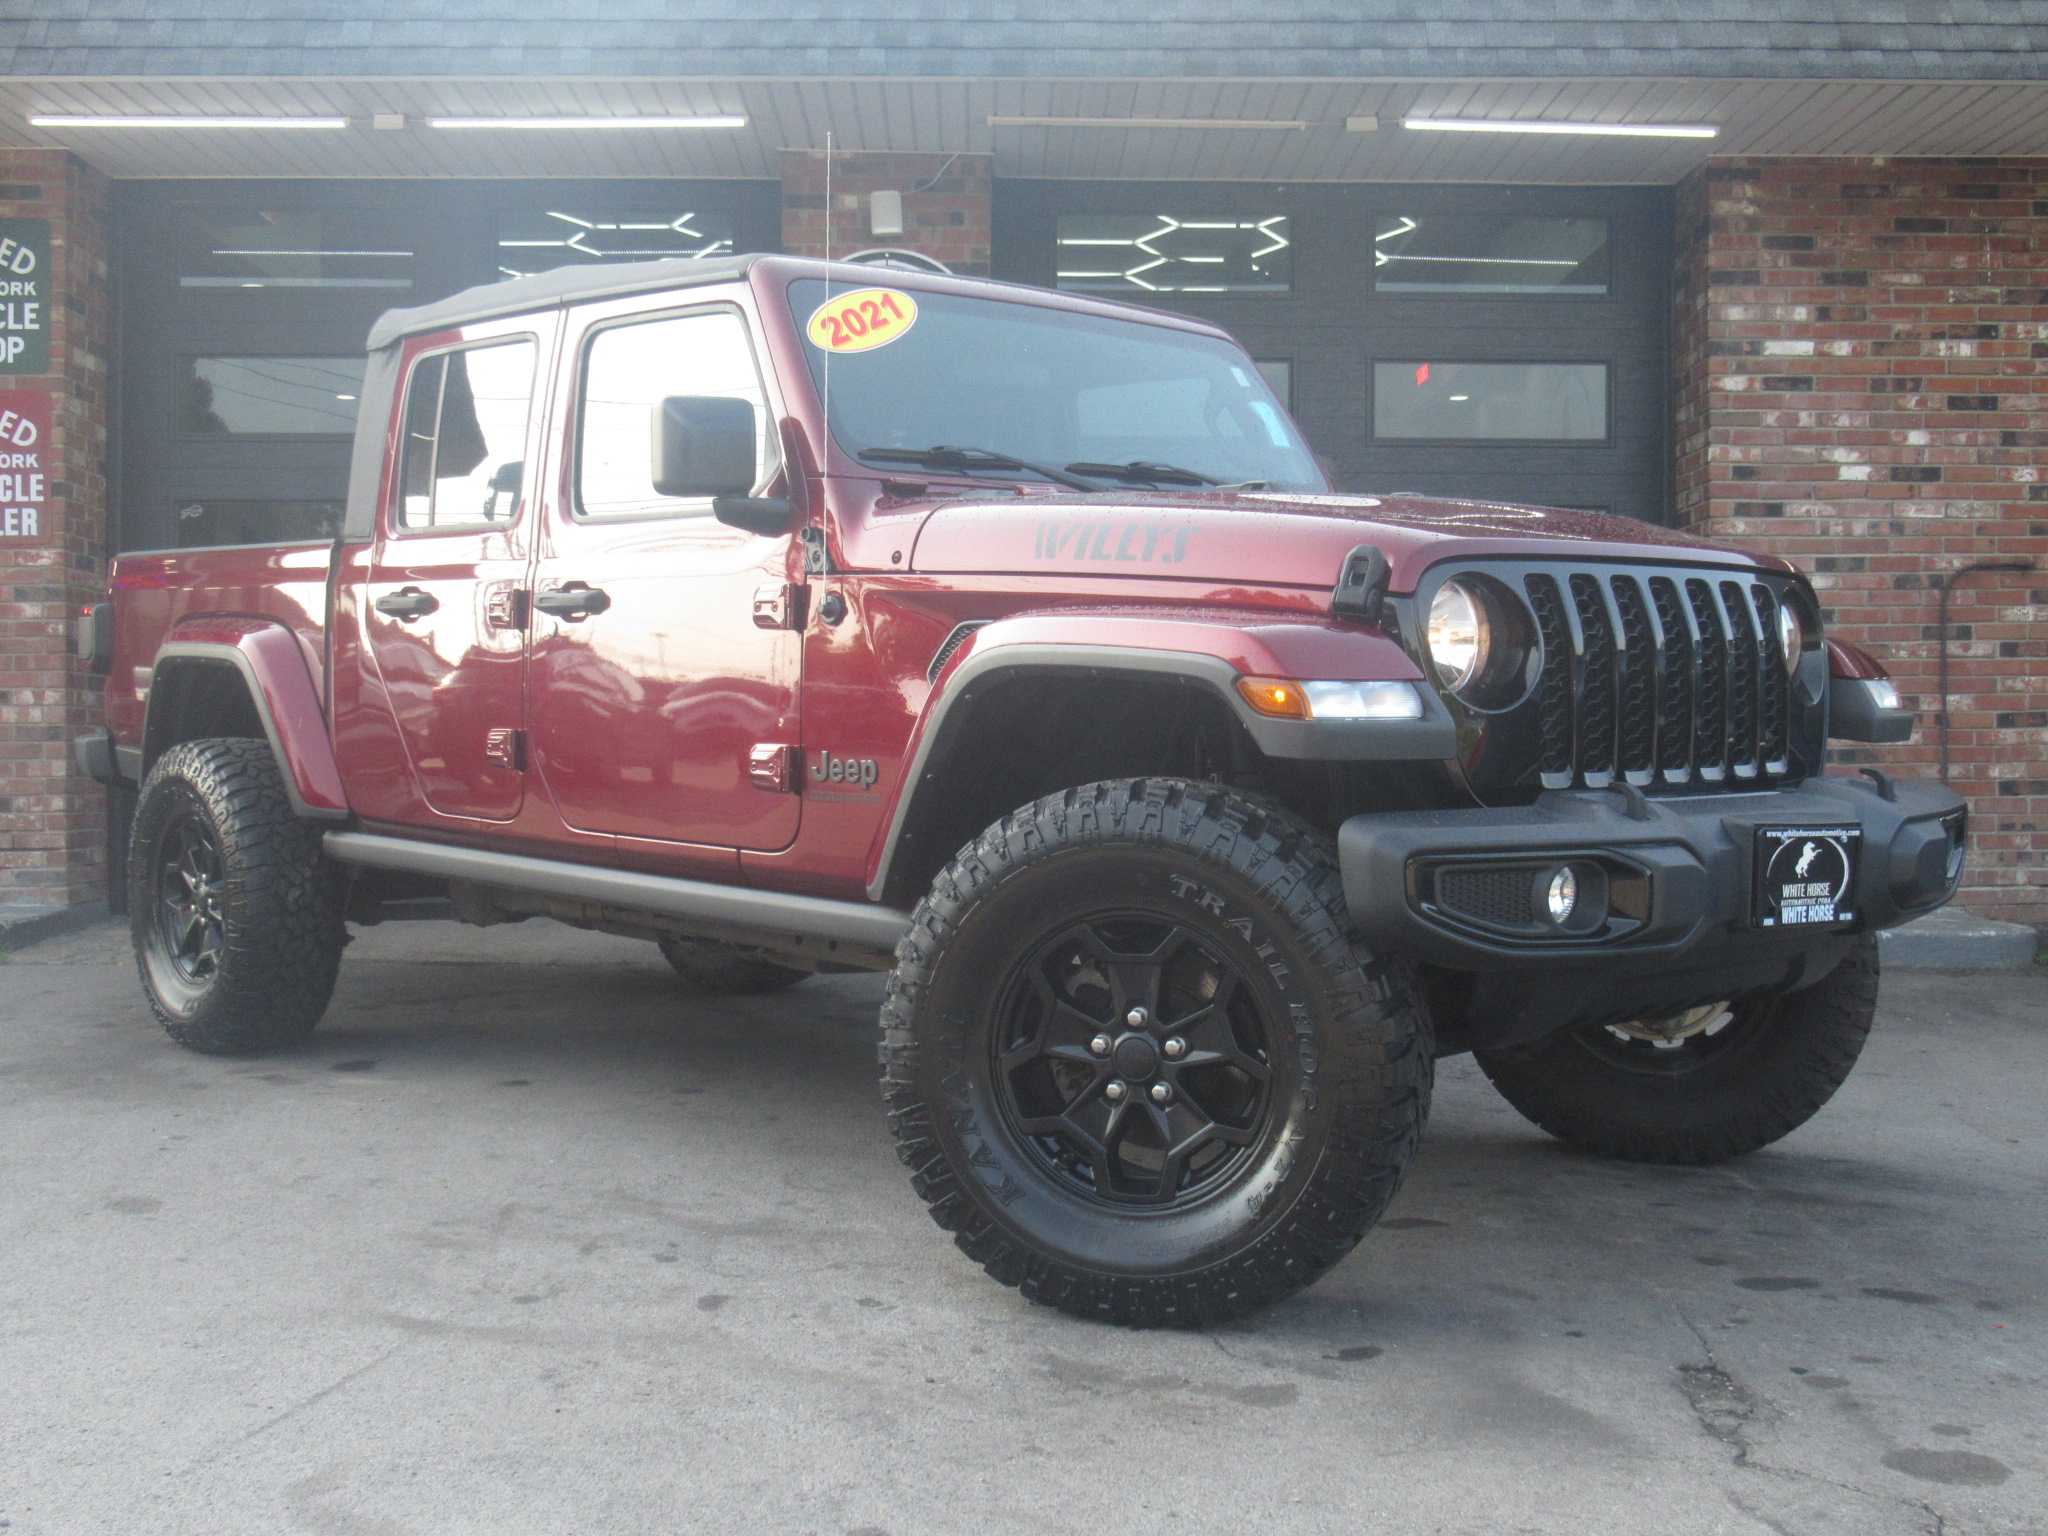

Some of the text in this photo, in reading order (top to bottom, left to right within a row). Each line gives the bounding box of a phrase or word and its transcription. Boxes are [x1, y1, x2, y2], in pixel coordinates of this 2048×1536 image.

[820, 292, 905, 348] 2021
[0, 507, 38, 536] ER
[1035, 522, 1200, 564] WILLYS
[811, 750, 877, 790] Jeep
[1766, 828, 1860, 838] www.whitehorseautomotive.com
[1782, 882, 1831, 898] WHITE HORSE
[1781, 905, 1807, 924] WHITE
[1808, 904, 1834, 922] HORSE
[1169, 872, 1290, 990] TRAIL
[1288, 1002, 1319, 1110] HOG
